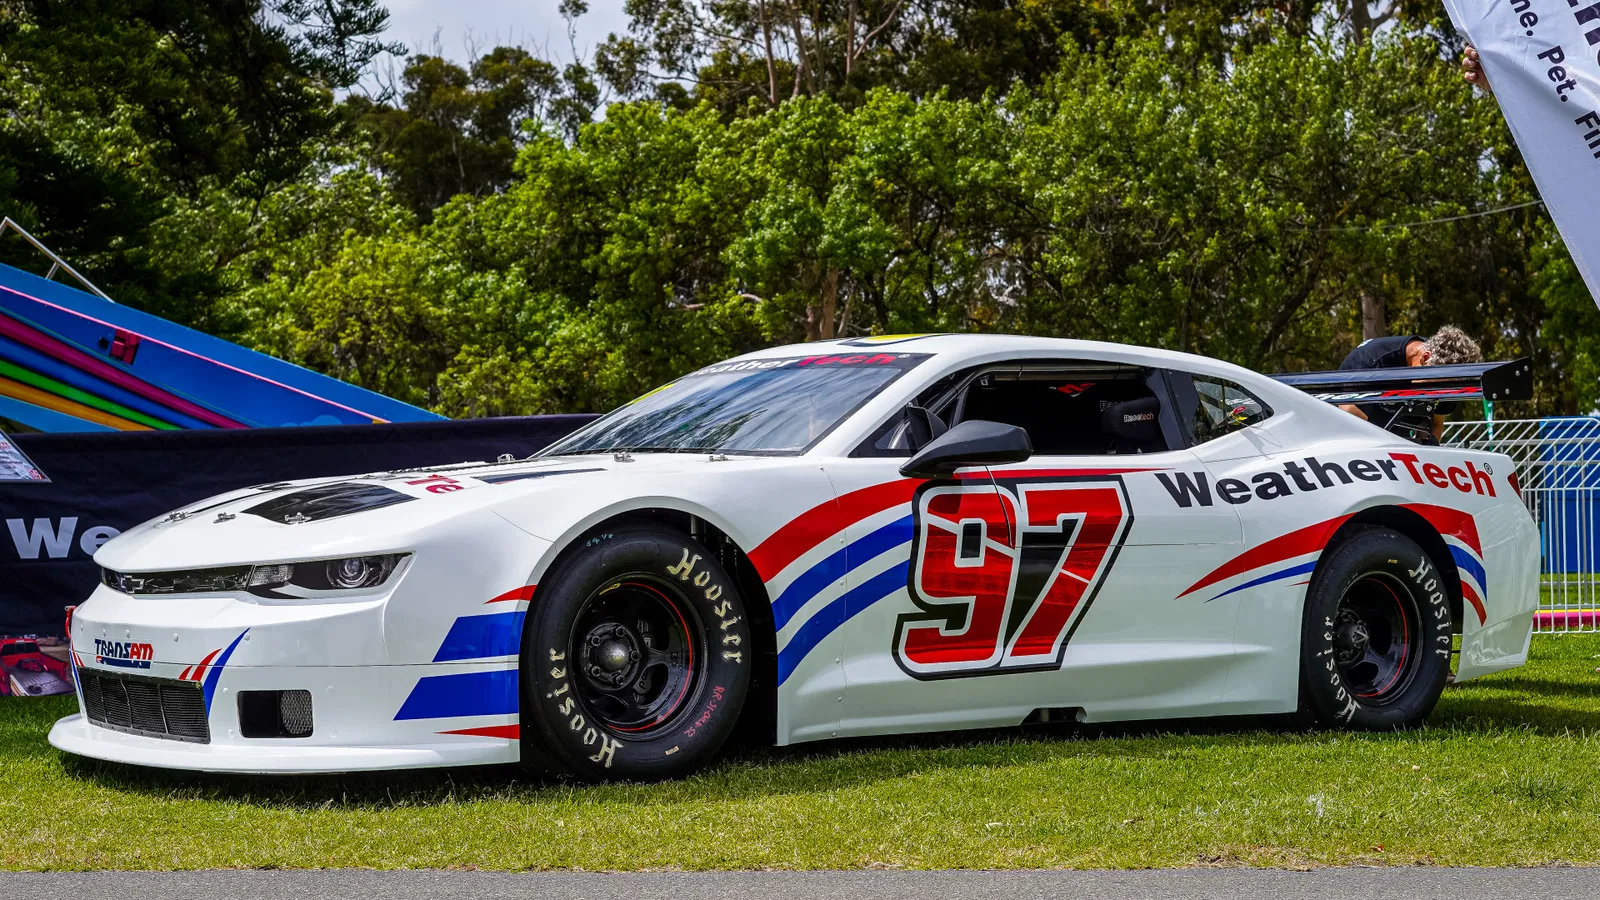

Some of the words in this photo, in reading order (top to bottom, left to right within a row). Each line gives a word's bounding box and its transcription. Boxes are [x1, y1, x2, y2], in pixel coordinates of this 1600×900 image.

[1537, 45, 1577, 102] Pet.
[666, 548, 743, 664] Hoosier
[897, 480, 1129, 674] 97
[1408, 556, 1452, 660] Hoosier
[546, 648, 624, 769] Hoosier
[1316, 616, 1362, 723] Hoosier
